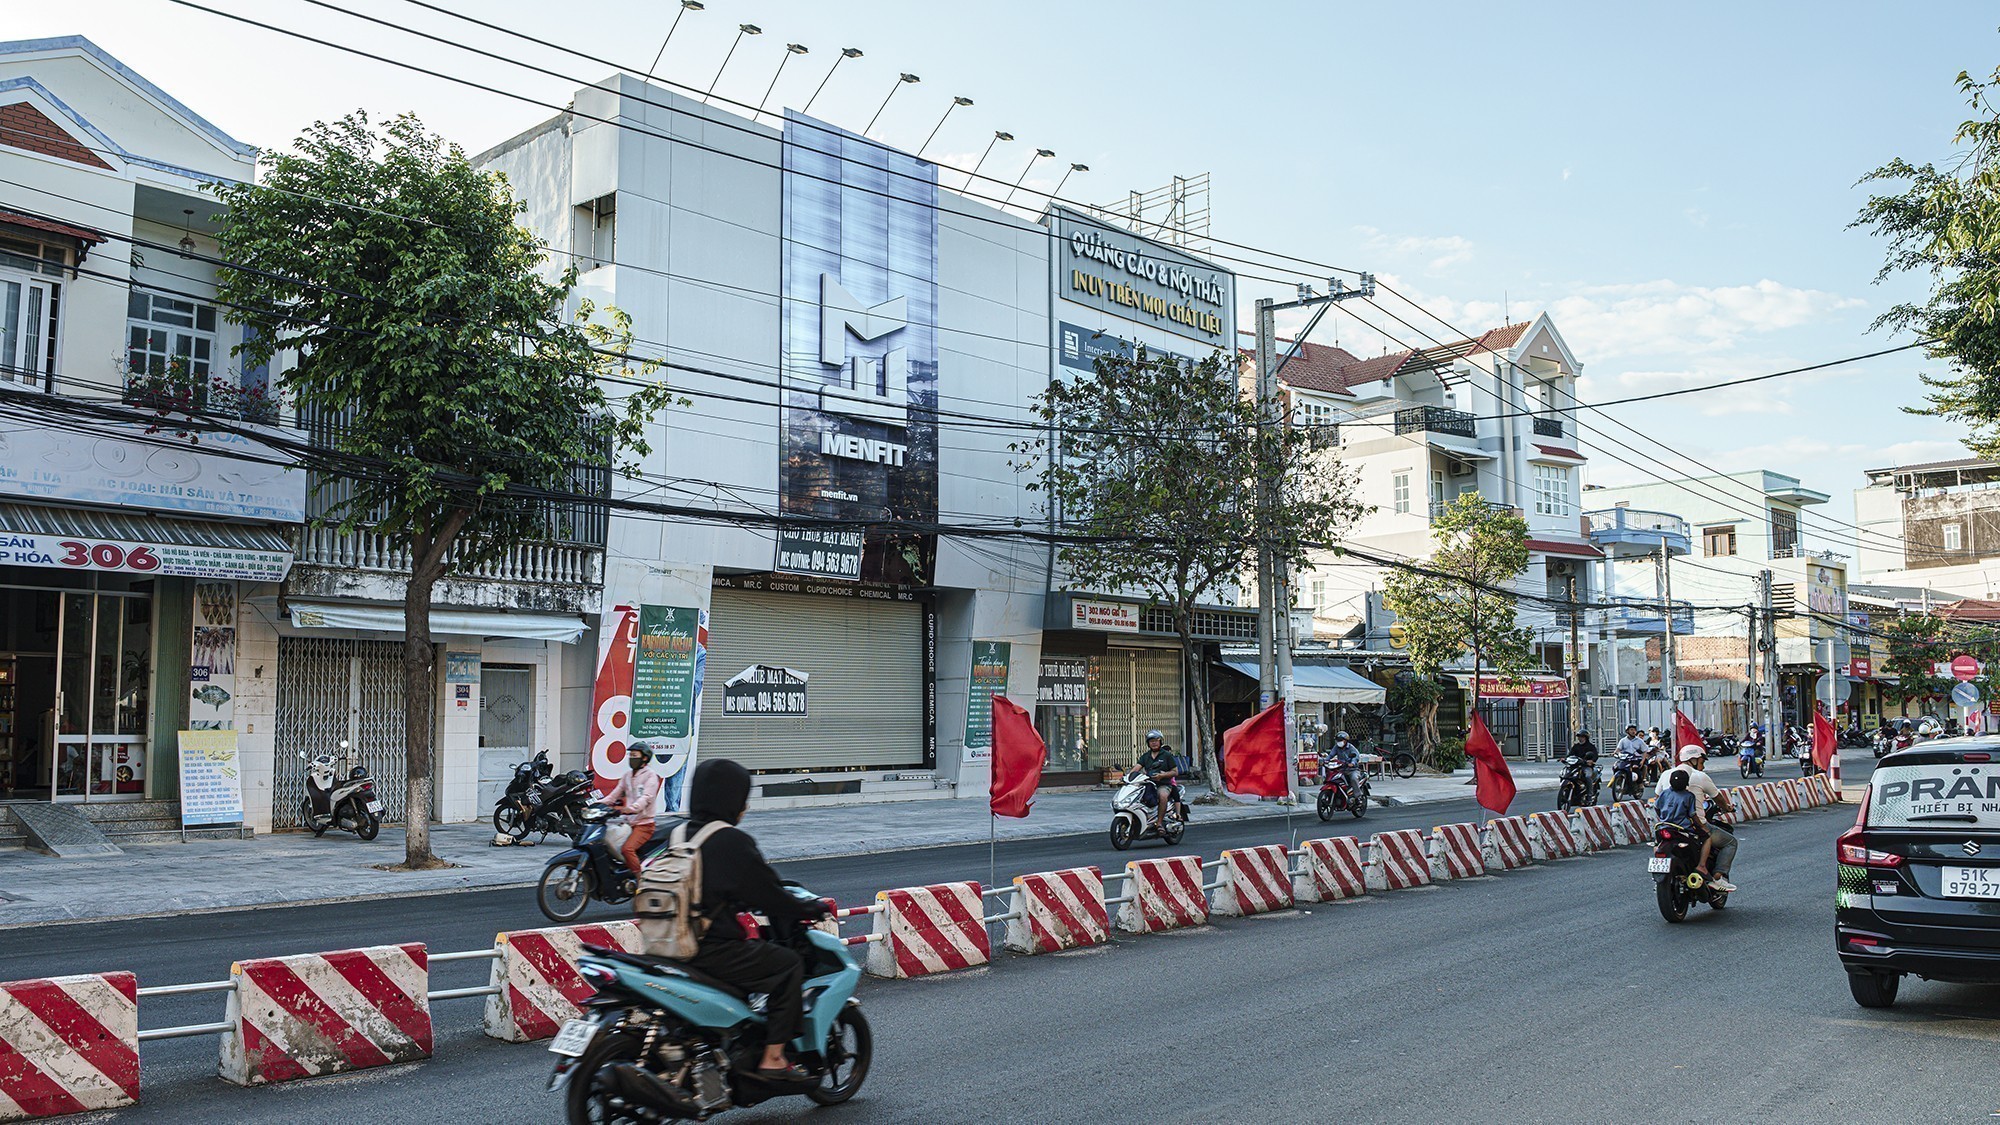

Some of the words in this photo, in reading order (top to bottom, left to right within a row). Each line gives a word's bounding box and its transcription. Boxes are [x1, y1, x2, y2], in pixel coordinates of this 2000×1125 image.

[1071, 230, 1125, 270] QUẢNG
[1126, 249, 1157, 281] CÁO
[1158, 264, 1168, 287] &
[1168, 266, 1192, 299] NỘI
[1194, 274, 1225, 308] THẤT
[1106, 281, 1140, 309] TRÊN
[1142, 294, 1166, 321] MỌI
[1169, 299, 1198, 327] CHẤT
[820, 430, 908, 468] MENFIT
[821, 490, 859, 502] menfit.vn
[15, 550, 54, 564] HÓA
[57, 540, 161, 571] 306
[811, 550, 825, 571] 094
[826, 551, 840, 573] 563
[840, 553, 858, 575] 9678
[770, 582, 799, 592] CUSTOM
[806, 585, 853, 597] CUPID'CHOICE
[860, 589, 892, 600] CHEMICAL
[1088, 606, 1099, 615] 302
[656, 651, 670, 659] CÁC
[193, 667, 209, 677] 306
[757, 692, 771, 712] 094
[772, 692, 786, 712] 563
[787, 692, 805, 712] 9678
[1911, 799, 1949, 814] THIẾT
[1957, 802, 1973, 814] BỊ
[1961, 868, 1988, 882] 51K
[1949, 882, 2000, 896] 979.27
